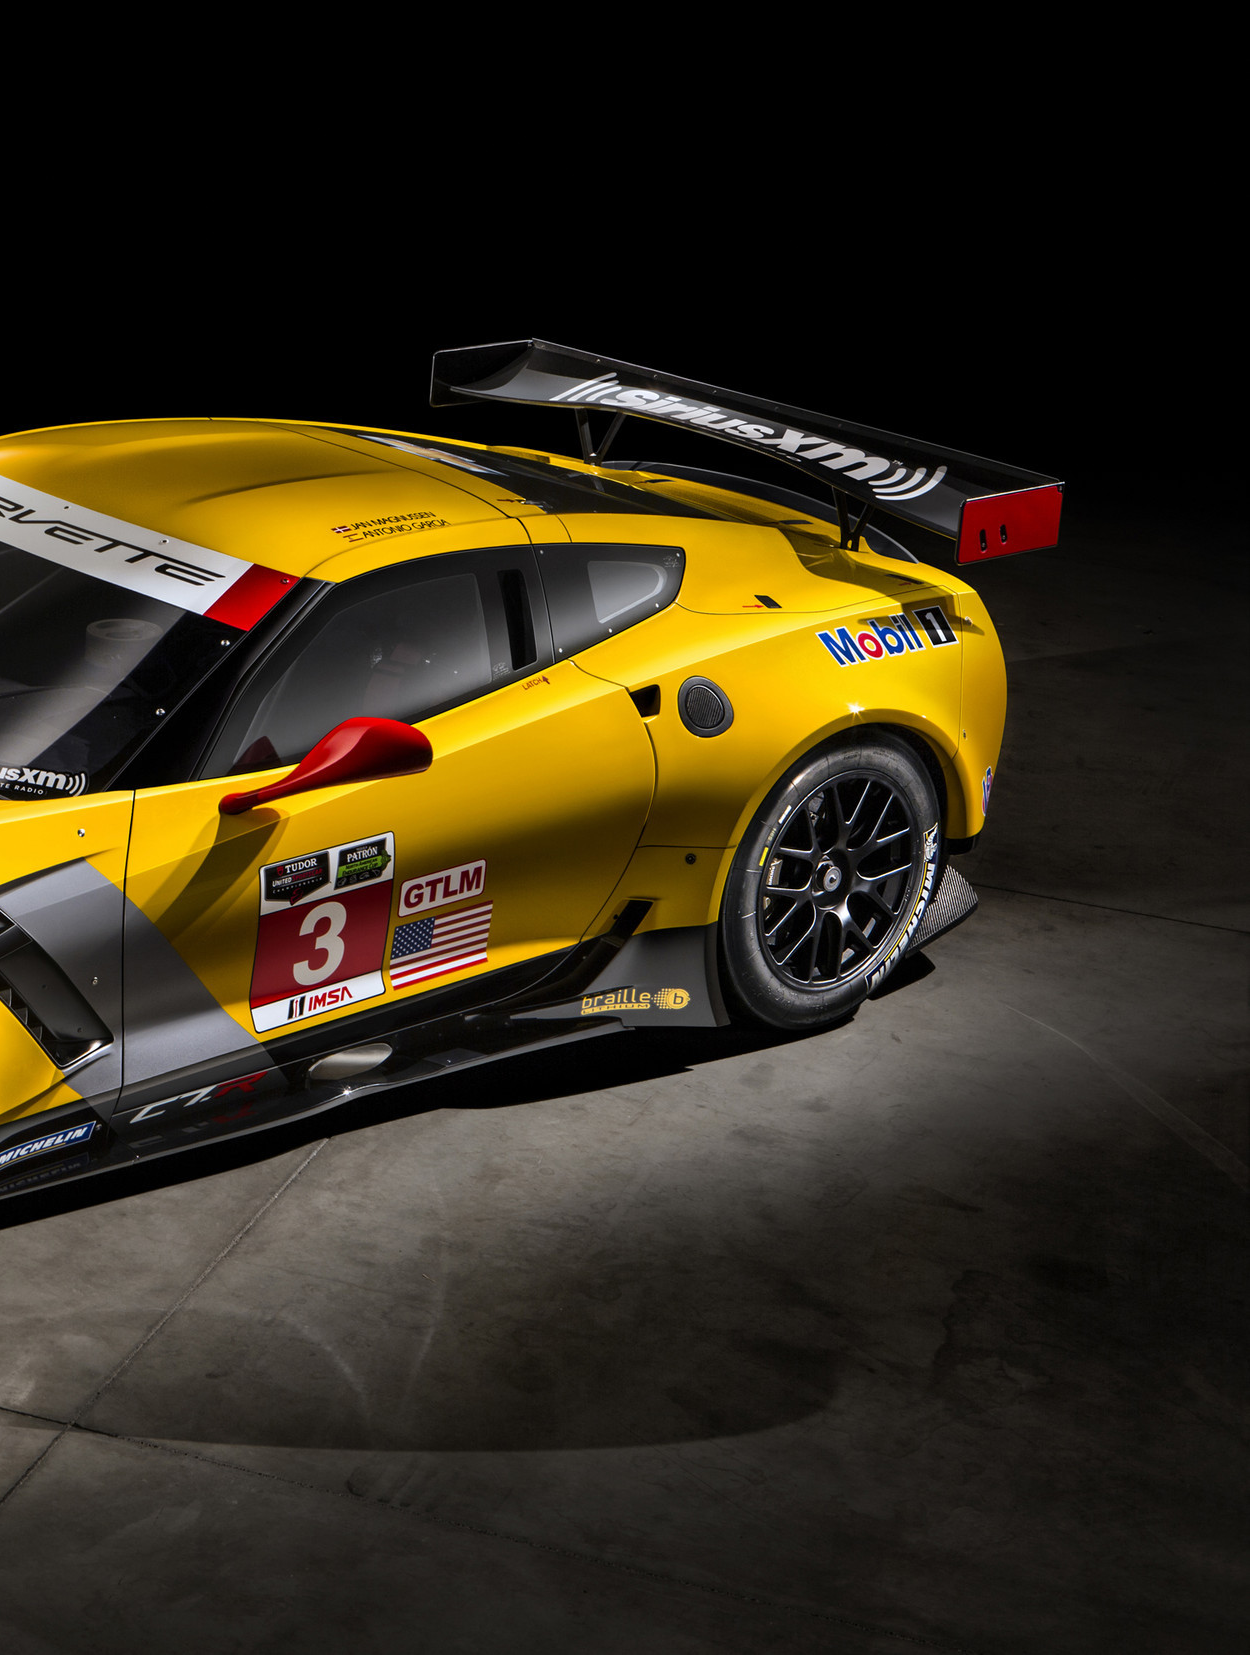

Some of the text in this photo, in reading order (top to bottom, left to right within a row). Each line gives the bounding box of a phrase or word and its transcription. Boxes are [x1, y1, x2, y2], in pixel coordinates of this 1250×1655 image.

[350, 511, 437, 531] JAN MAGNUSSEN
[362, 519, 452, 539] ANTONIO GARCIA
[815, 613, 926, 667] Mobil
[521, 676, 544, 691] LATCH
[14, 784, 44, 795] RADIO
[347, 846, 378, 863] PATRÓN
[285, 857, 318, 874] TUDOR
[272, 876, 293, 888] UNITED
[403, 866, 481, 909] GTLM
[292, 901, 348, 986] 3
[308, 986, 353, 1012] IMSA
[582, 988, 651, 1009] braille
